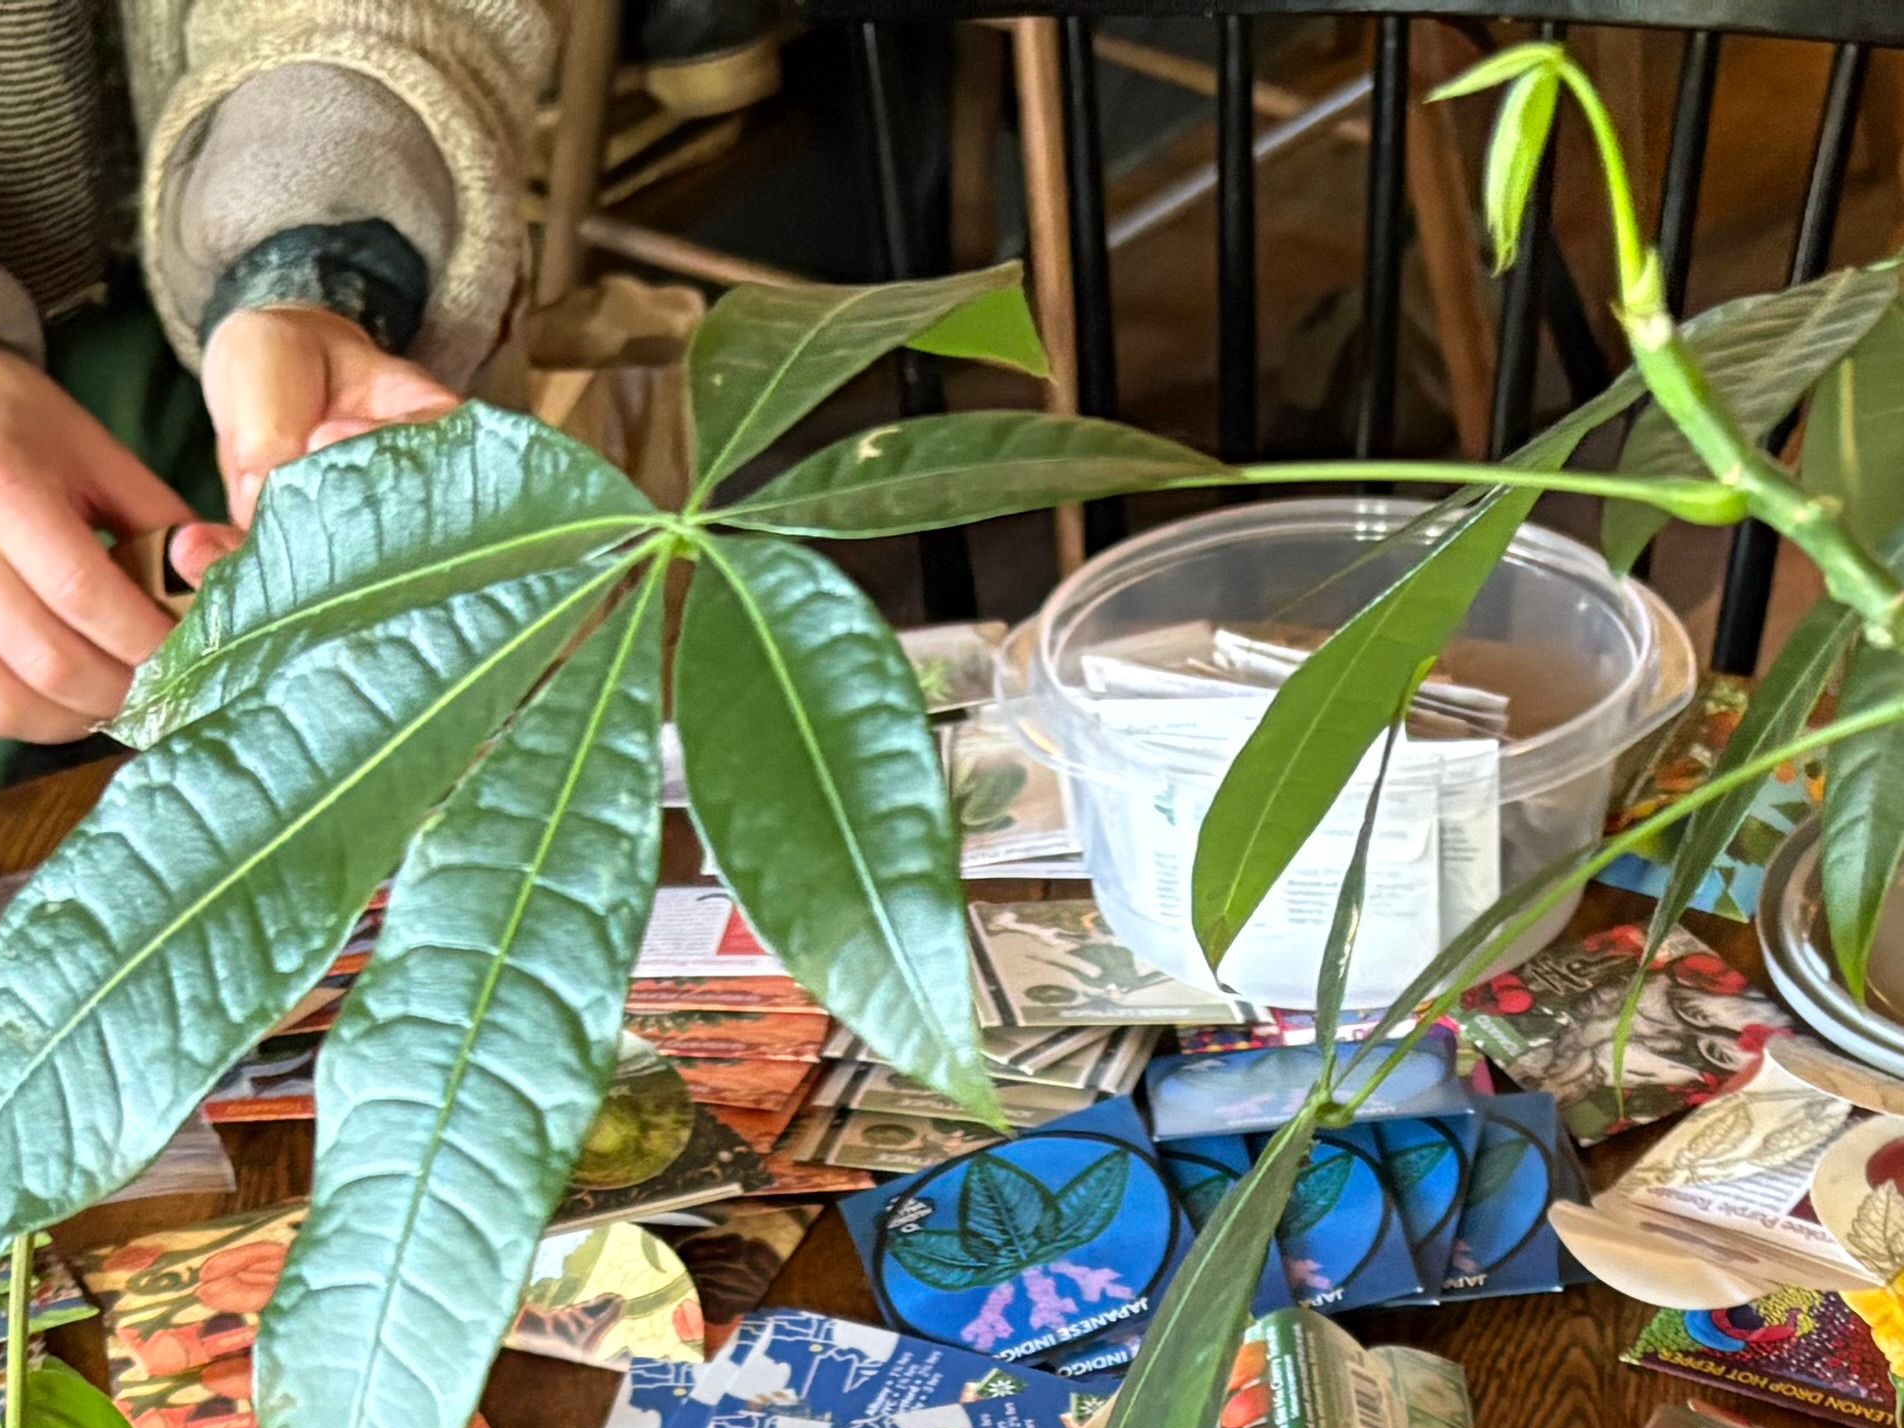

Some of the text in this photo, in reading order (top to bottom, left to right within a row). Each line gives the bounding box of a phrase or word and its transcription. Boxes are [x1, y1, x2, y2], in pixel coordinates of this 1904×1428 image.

[1057, 1297, 1148, 1341] JAPANESE
[1057, 1351, 1128, 1377] INDIGO
[1726, 1370, 1769, 1387] HOT
[1769, 1383, 1825, 1404] DROP
[1826, 1396, 1893, 1425] LEMON
